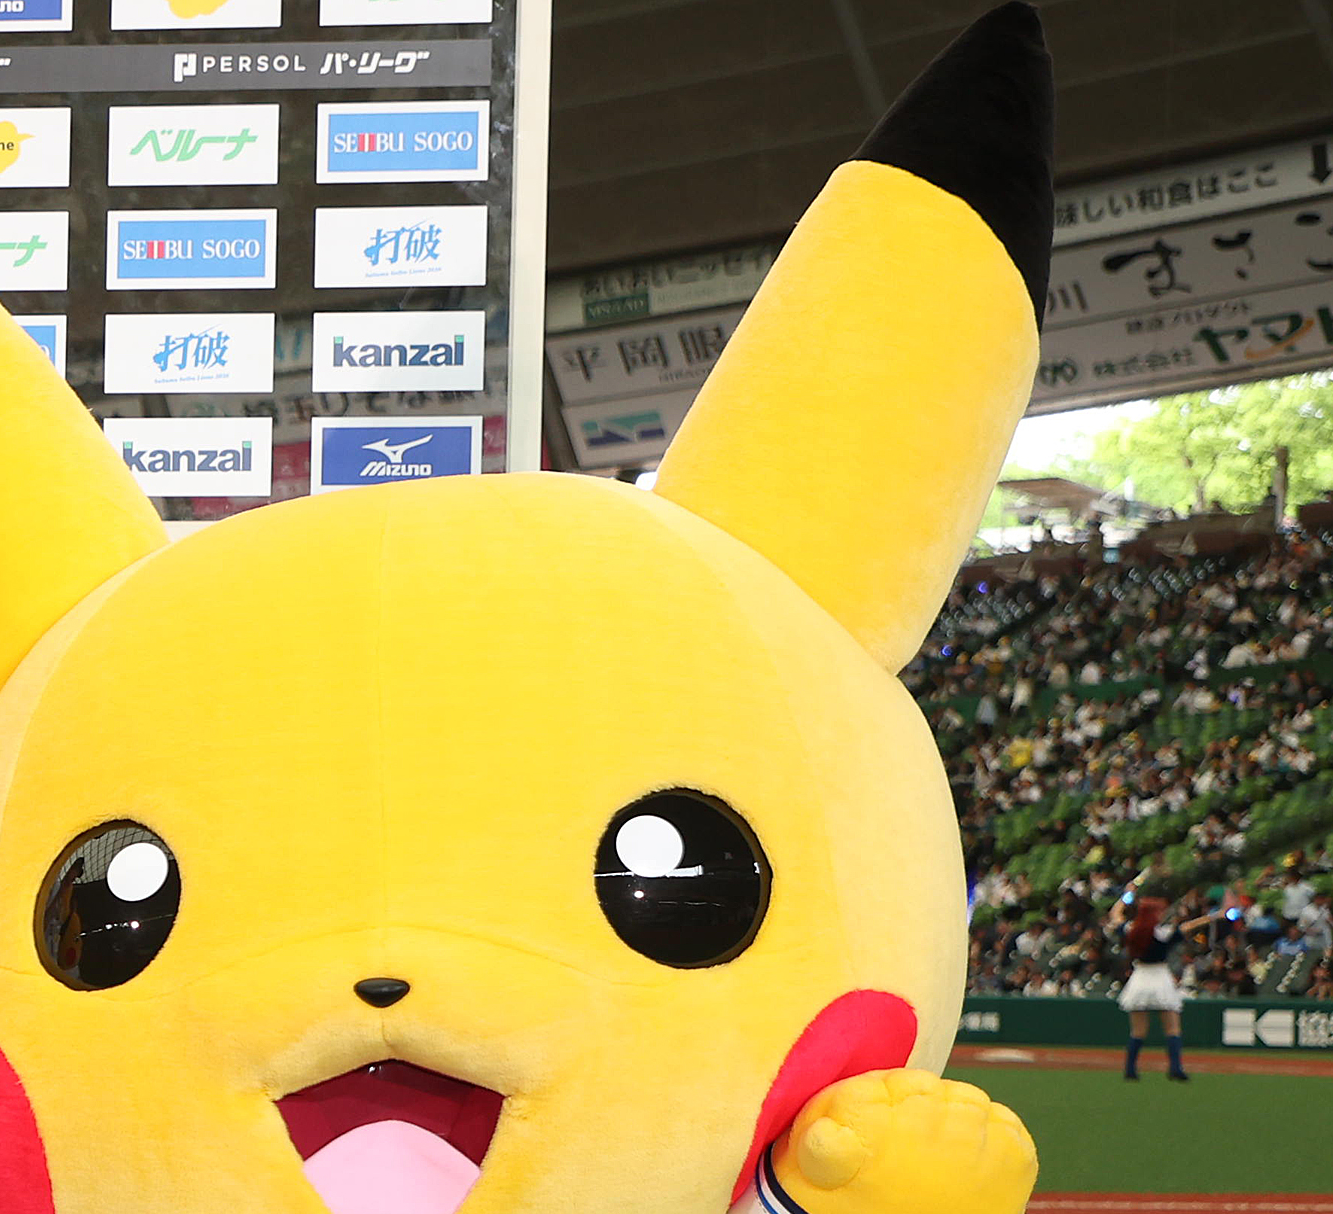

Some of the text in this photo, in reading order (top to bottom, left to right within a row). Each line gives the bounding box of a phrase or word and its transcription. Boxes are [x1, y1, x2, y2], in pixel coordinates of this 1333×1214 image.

[202, 55, 307, 73] PERSOL
[130, 127, 259, 163] ベルーナ
[332, 129, 474, 153] SEIBU SOGO
[123, 238, 261, 260] SEIBU SOGO
[363, 222, 443, 267] 打破
[152, 329, 231, 372] 打破
[333, 334, 465, 367] kanzai
[123, 440, 252, 472] kanzai
[359, 461, 432, 477] MIZUNO
